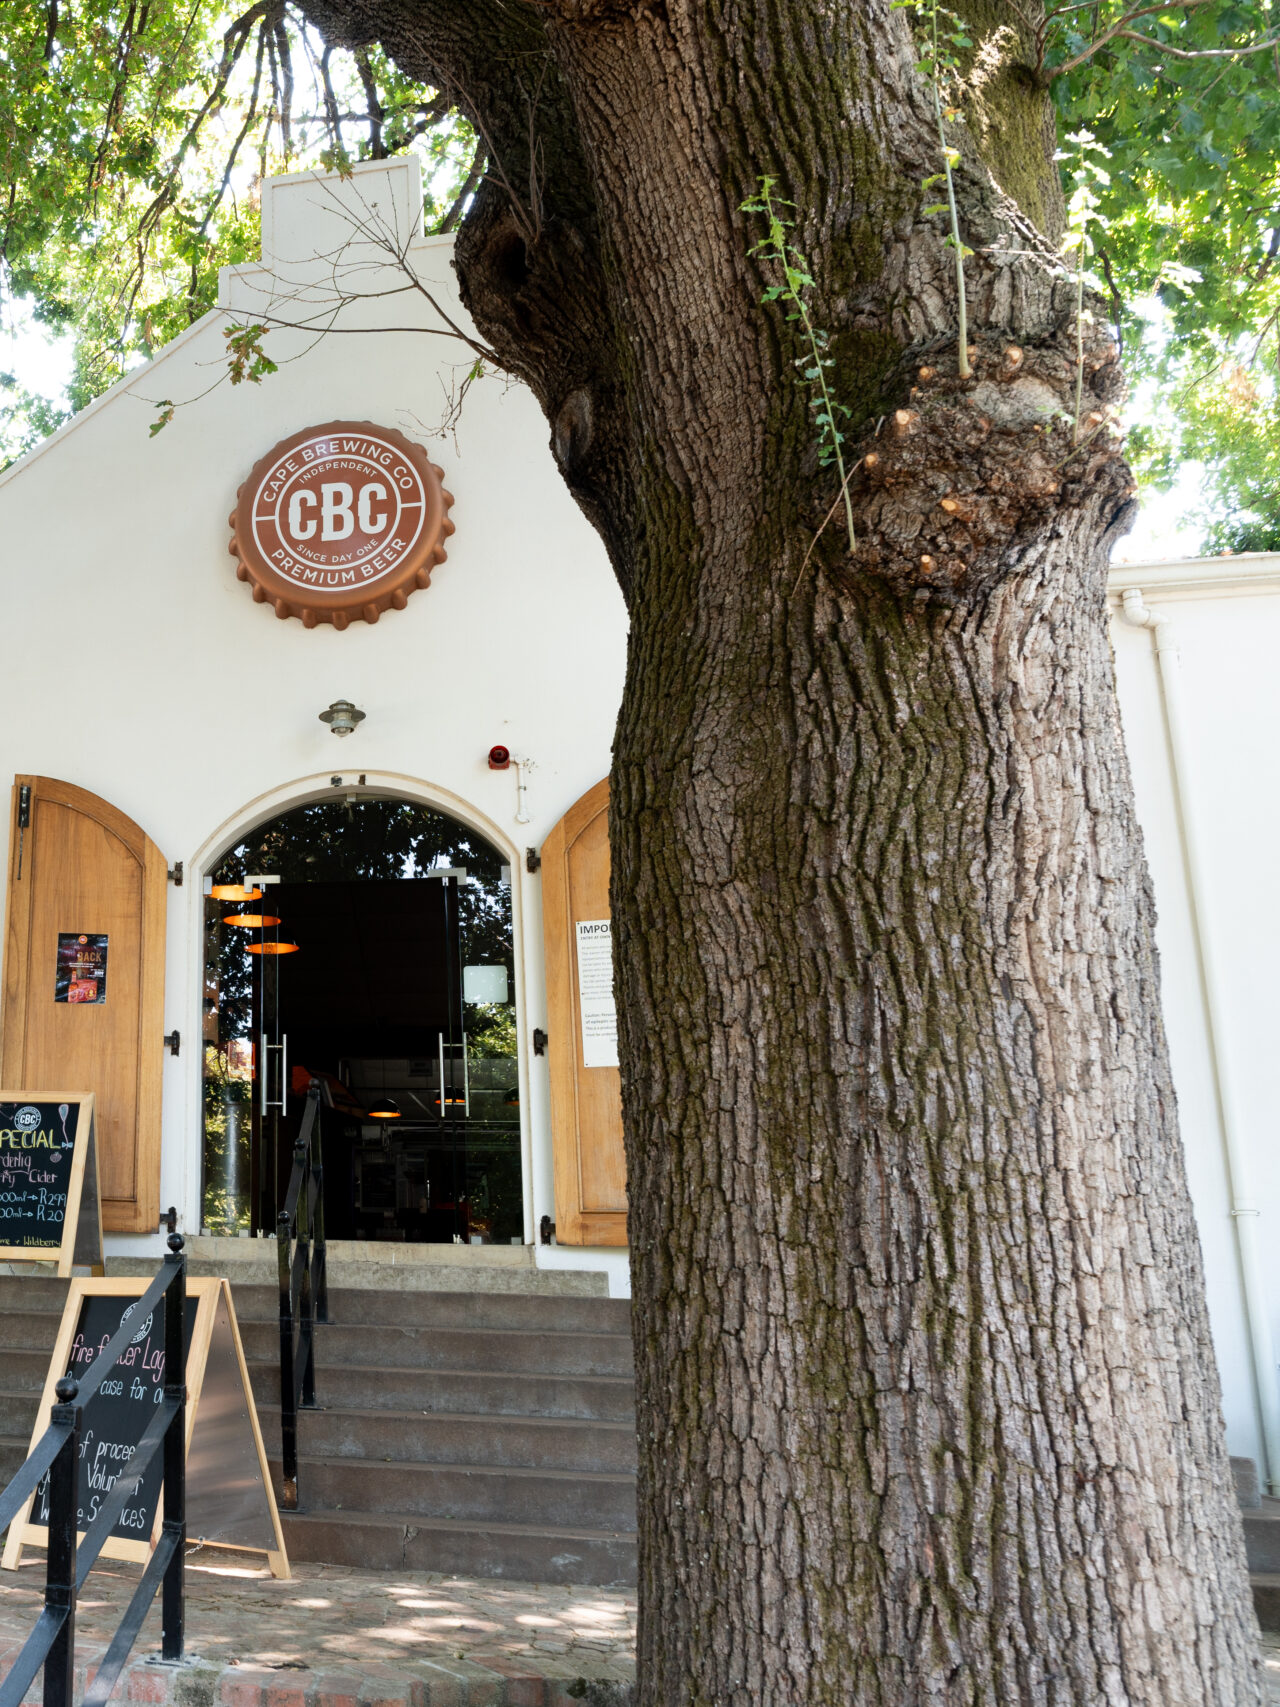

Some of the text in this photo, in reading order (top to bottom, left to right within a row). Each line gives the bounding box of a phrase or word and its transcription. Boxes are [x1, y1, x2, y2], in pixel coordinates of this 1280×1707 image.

[263, 439, 413, 502] CAPE BREWING CO
[299, 461, 377, 484] INDEPENDENT
[288, 482, 387, 541] CBC
[271, 537, 406, 585] PREMIUM BEER
[297, 538, 378, 563] SINCE DAY ONE
[77, 952, 102, 962] BACK
[20, 1114, 36, 1124] CBC
[28, 1169, 58, 1183] Cider
[38, 1187, 67, 1207] R299
[142, 1336, 165, 1382] Lag
[100, 1380, 123, 1395] case
[130, 1377, 147, 1400] for
[94, 1441, 136, 1469] procee
